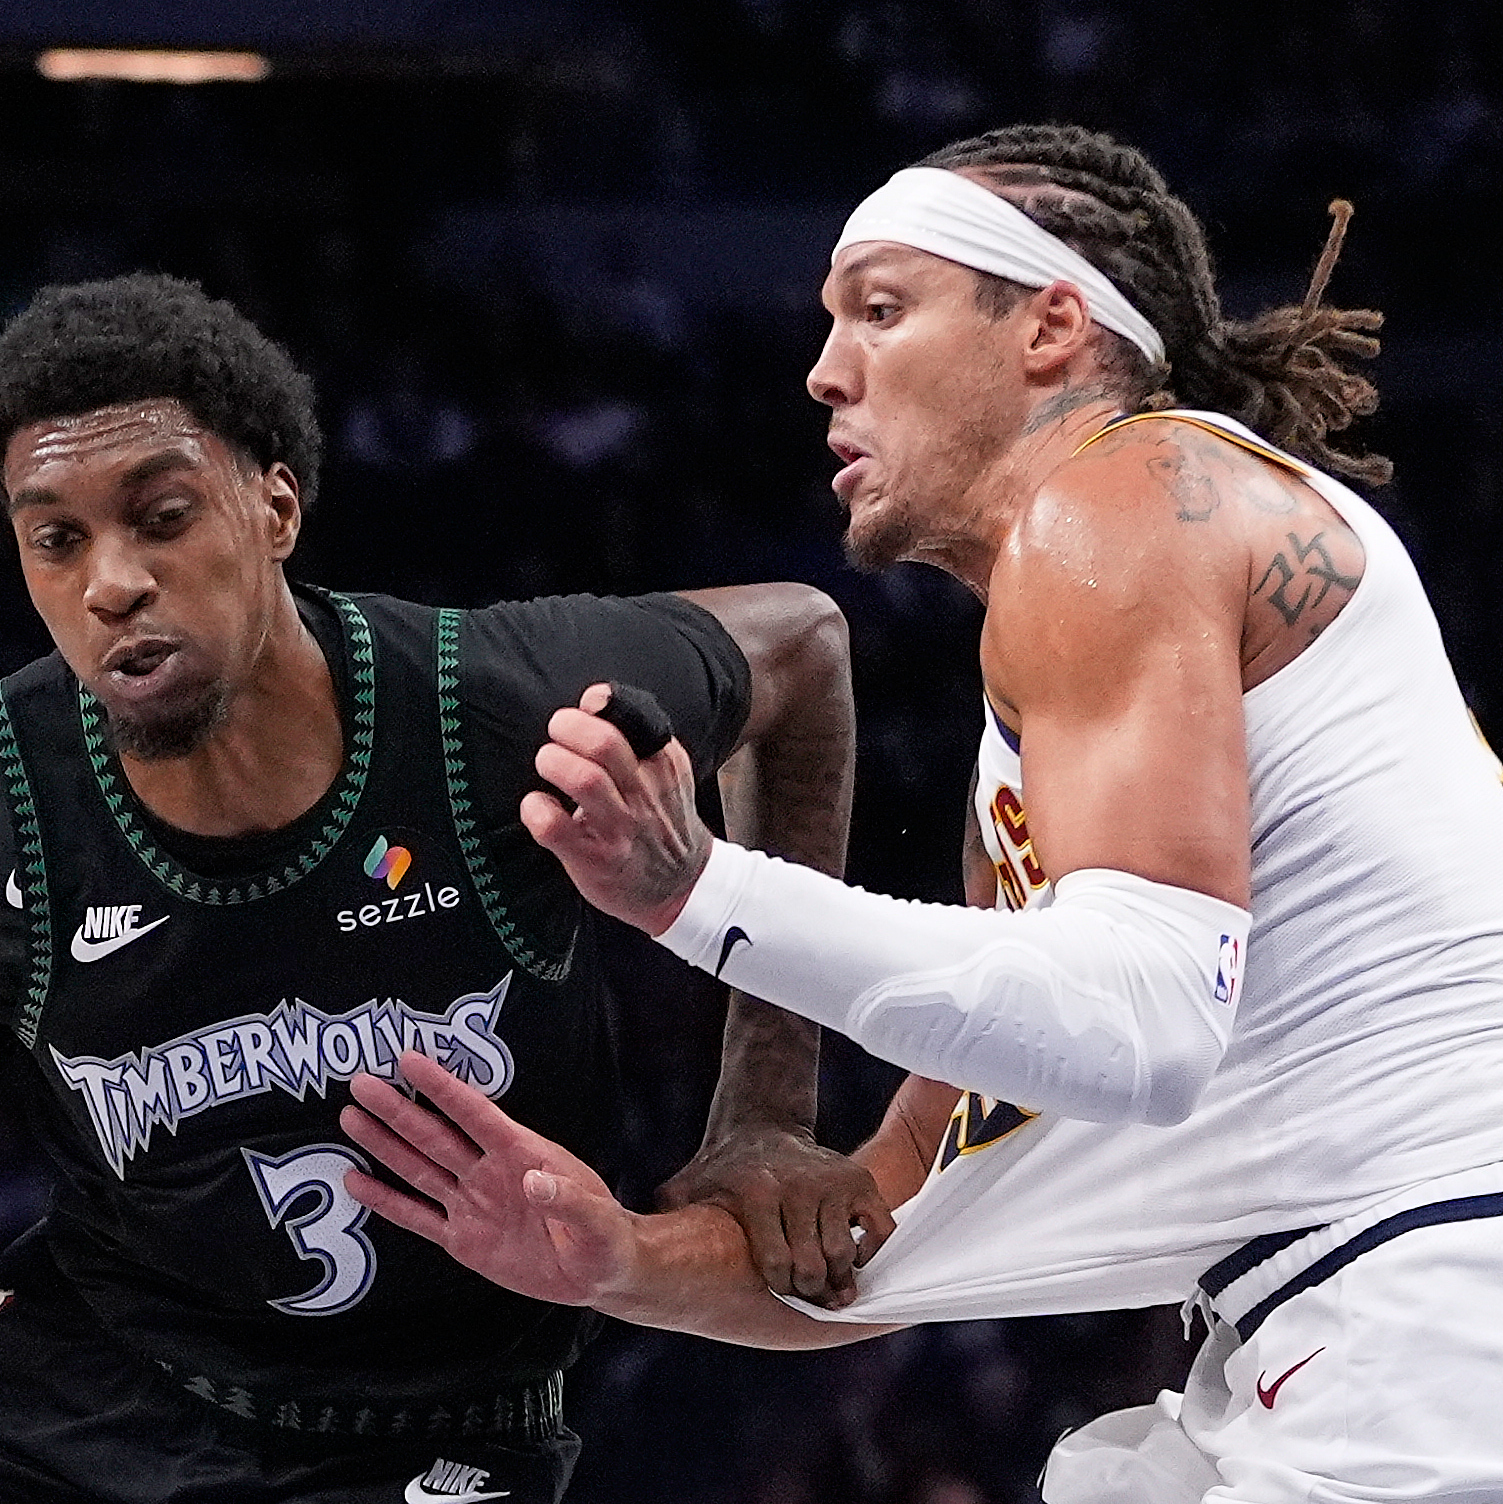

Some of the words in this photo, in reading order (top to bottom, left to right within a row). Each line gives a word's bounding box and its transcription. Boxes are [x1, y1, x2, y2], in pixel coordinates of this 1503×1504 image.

[83, 904, 143, 939] NIKE
[336, 881, 460, 932] sezzle
[240, 1143, 377, 1317] 3
[422, 1457, 491, 1497] NIKE
